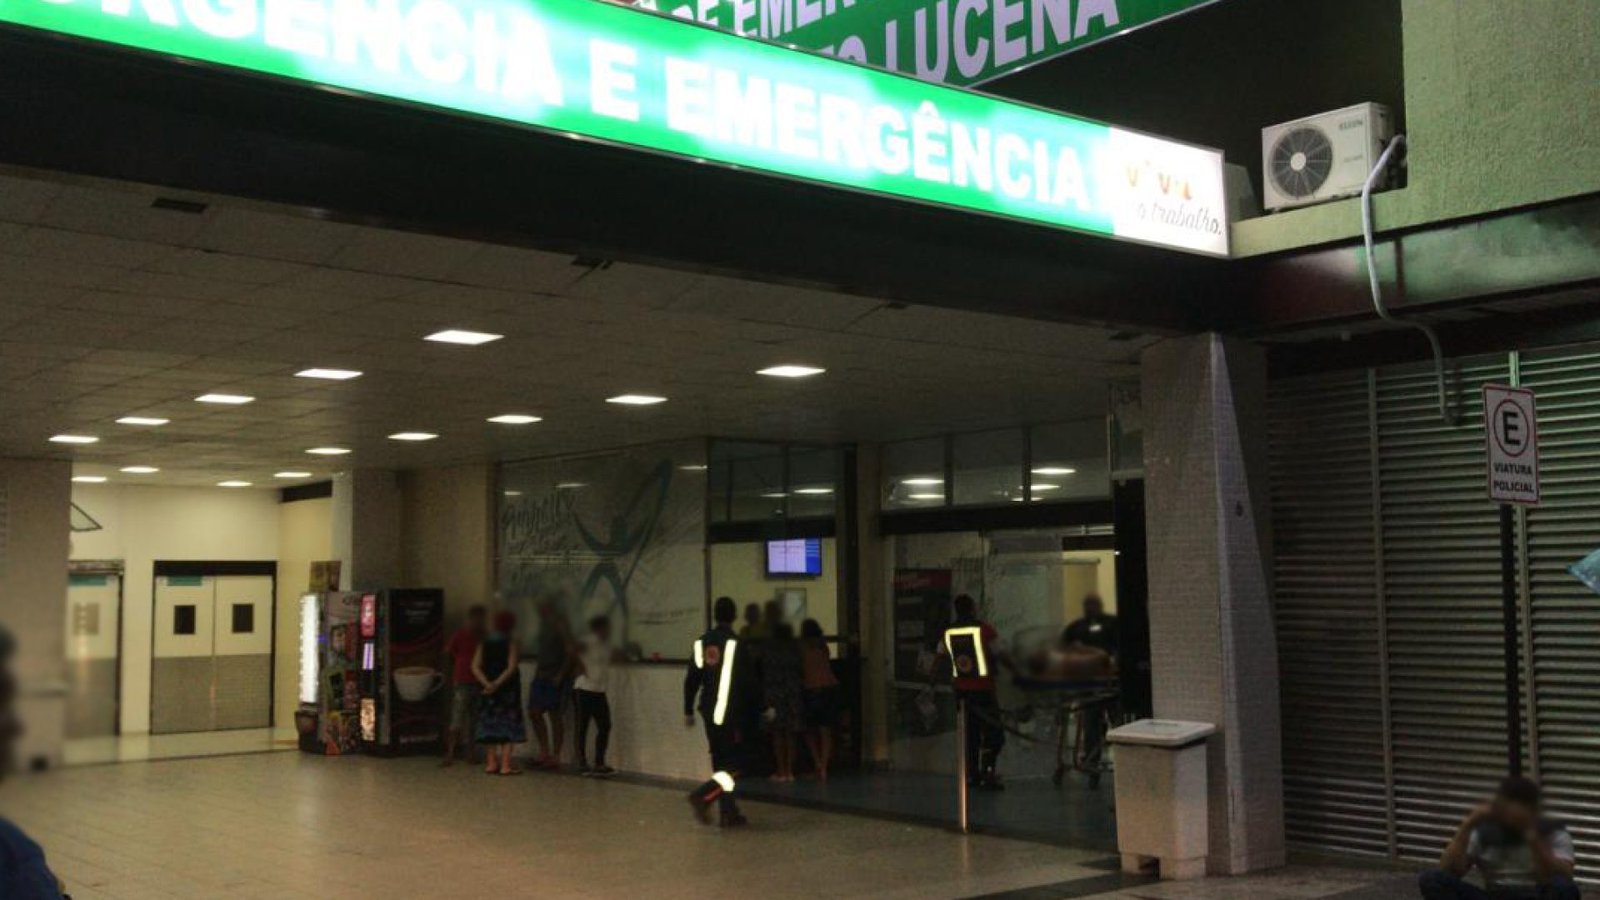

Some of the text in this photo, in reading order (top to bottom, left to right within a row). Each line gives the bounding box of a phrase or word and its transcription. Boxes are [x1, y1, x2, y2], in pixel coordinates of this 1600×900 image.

[589, 38, 639, 121] E
[665, 57, 1090, 211] EMERGÊNCIA
[1502, 411, 1521, 445] E
[1494, 463, 1532, 475] VIATURA
[1494, 481, 1534, 493] POLICIAL
